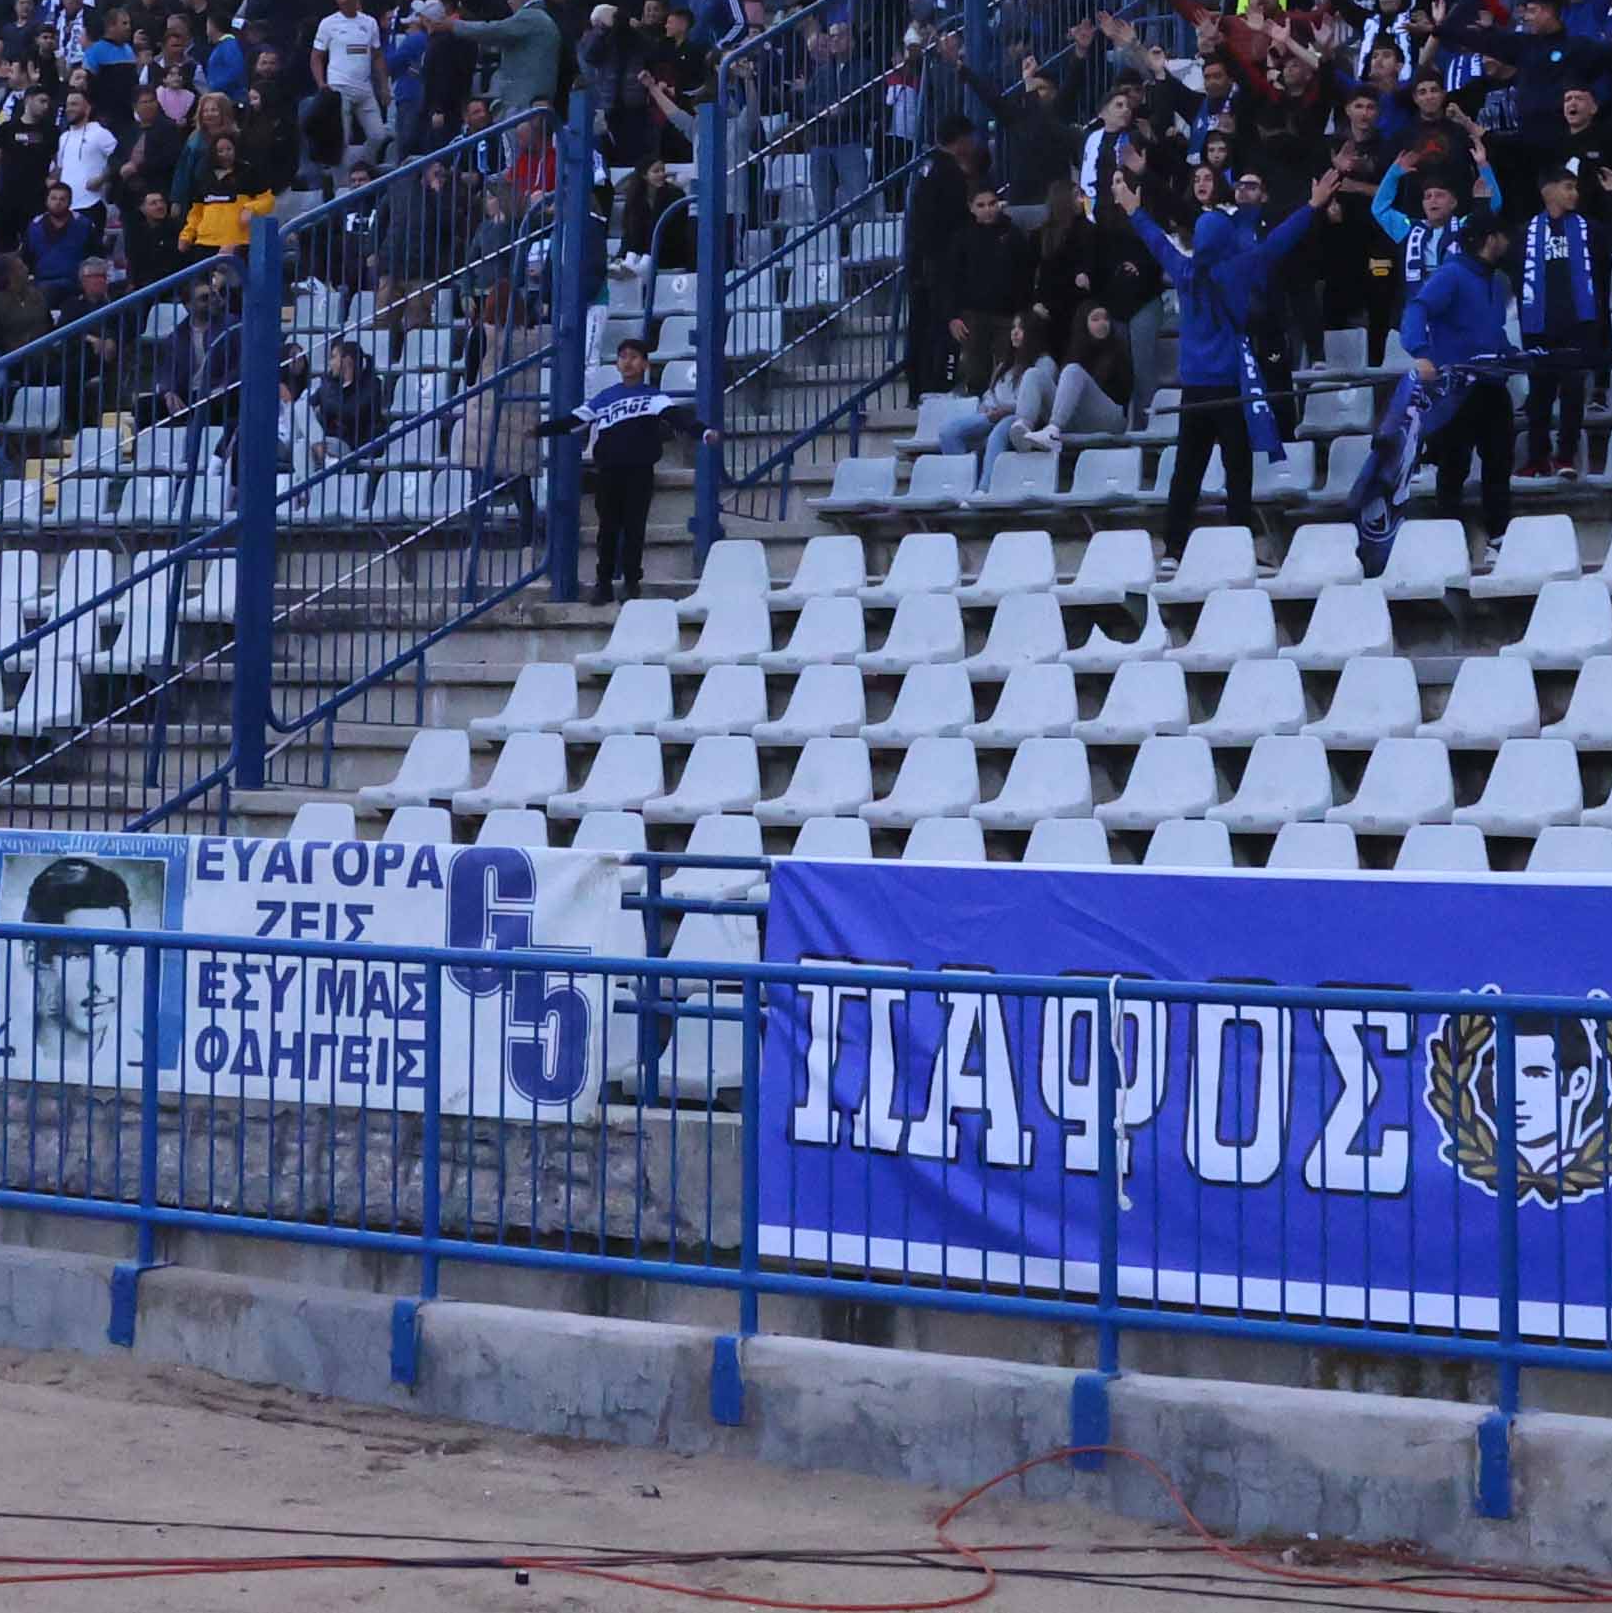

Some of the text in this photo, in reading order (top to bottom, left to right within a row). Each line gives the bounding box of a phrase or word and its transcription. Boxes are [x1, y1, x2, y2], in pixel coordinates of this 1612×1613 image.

[196, 838, 444, 890] ΕΥΑΓΟΡΑ
[256, 900, 374, 943] ΖΕΙΣ
[198, 961, 428, 1021] ΕΣΥ ΜΑΣ
[195, 1025, 428, 1088] ΟΔΗΓΕΙΣ
[788, 955, 1415, 1199] ΠΑΦΟΣ
